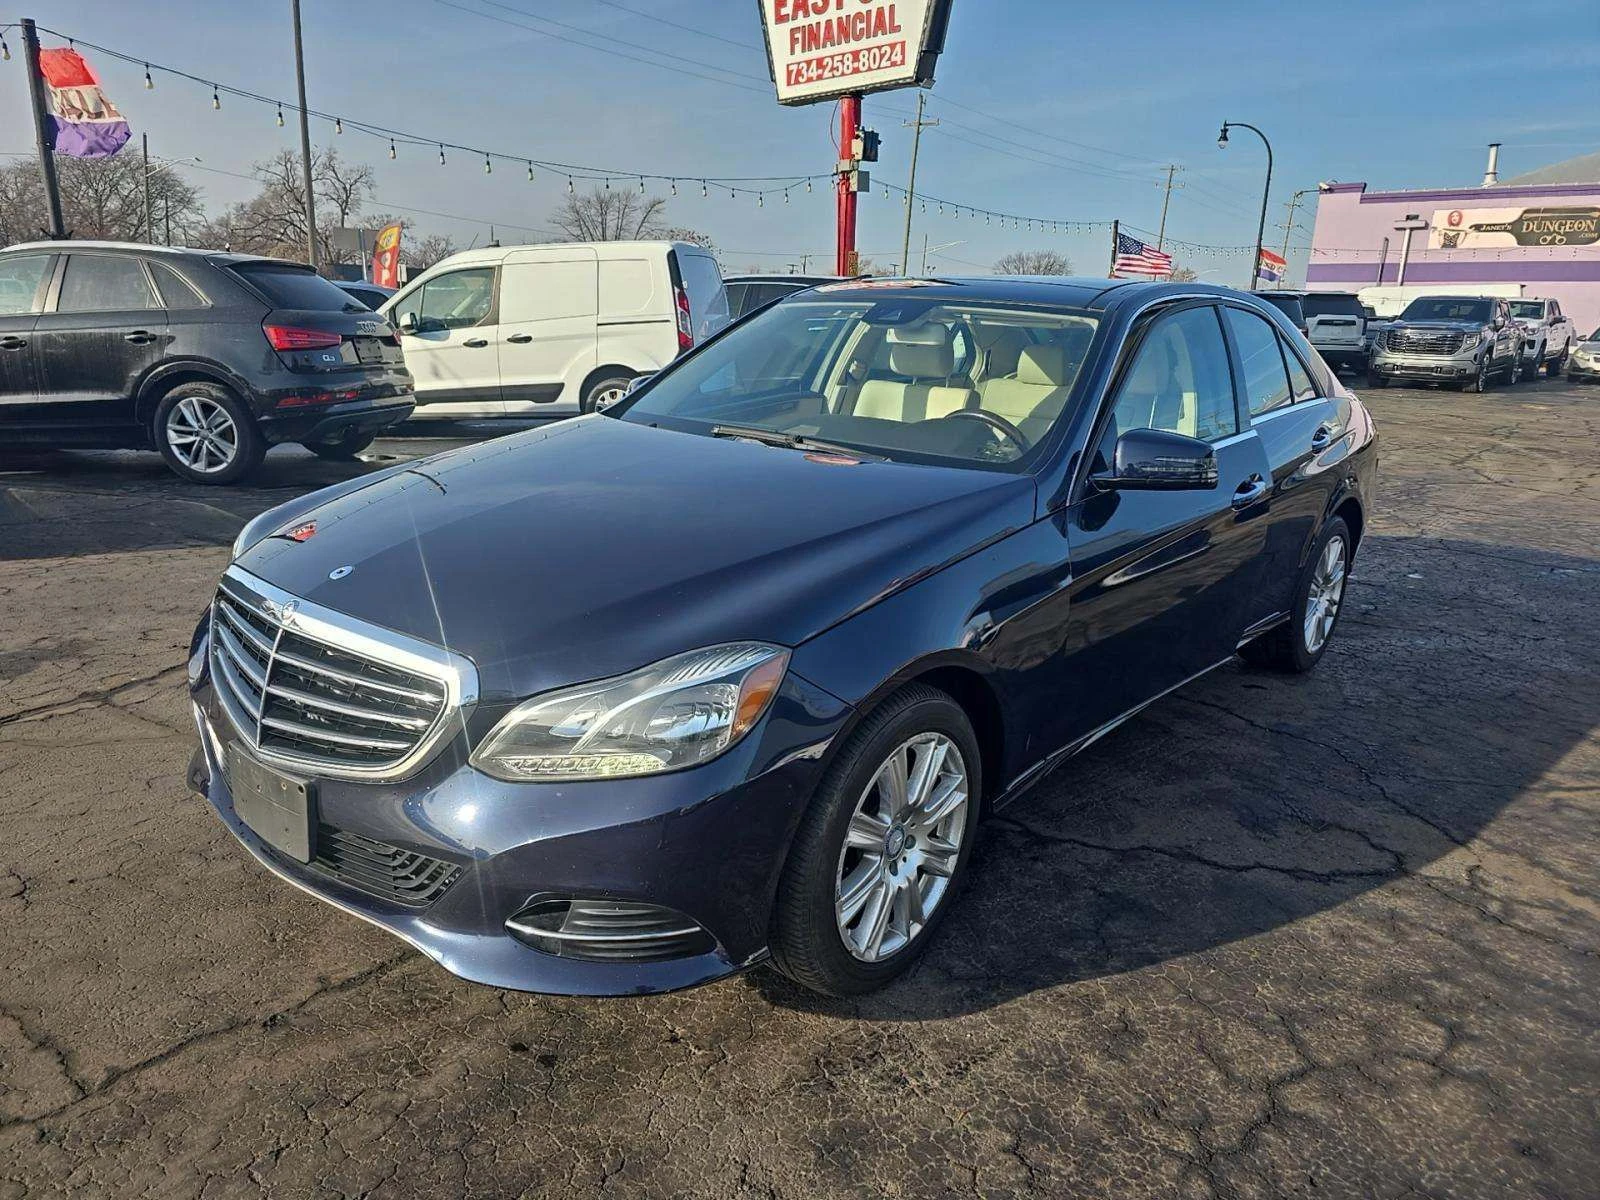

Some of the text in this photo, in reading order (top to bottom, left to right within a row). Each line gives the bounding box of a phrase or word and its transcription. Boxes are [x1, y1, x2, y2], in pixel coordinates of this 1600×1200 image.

[789, 4, 902, 56] FINANCIAL
[788, 43, 903, 85] 734-258-8024
[1521, 219, 1597, 234] DUNGEON
